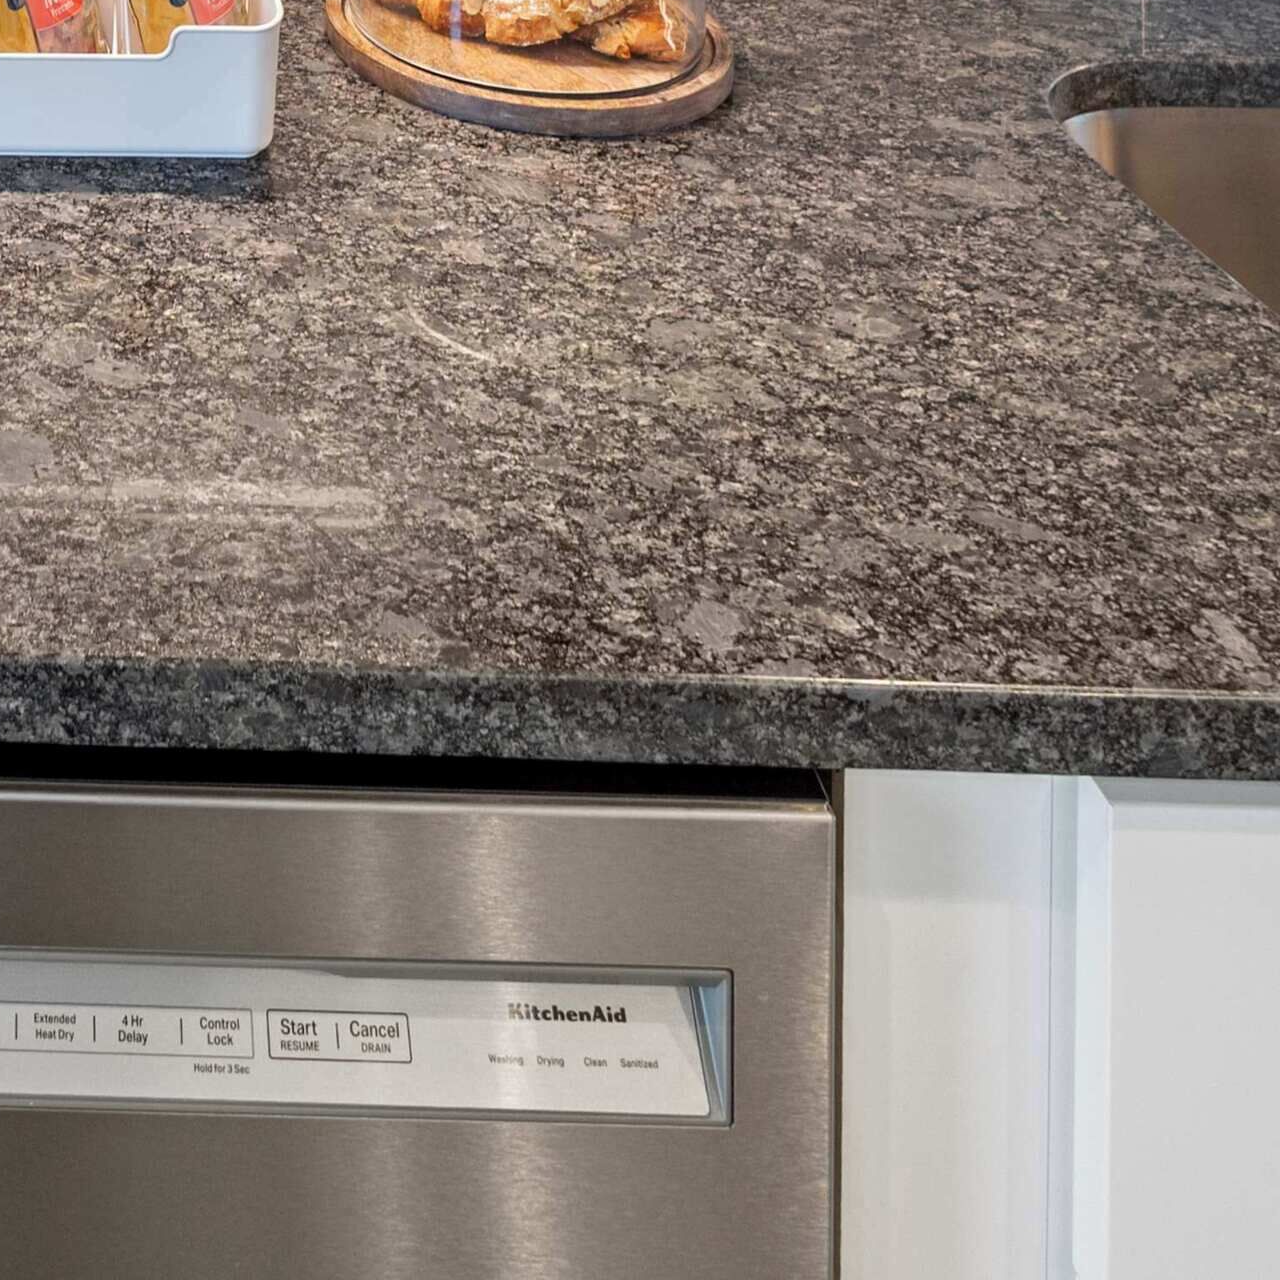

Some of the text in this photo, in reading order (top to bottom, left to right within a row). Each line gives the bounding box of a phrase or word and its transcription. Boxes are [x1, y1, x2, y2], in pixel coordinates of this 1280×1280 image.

[33, 1012, 77, 1025] Extended
[507, 1002, 628, 1024] KitchenAid
[121, 1016, 144, 1028] 4 Hr
[199, 1016, 241, 1031] Control
[280, 1017, 319, 1037] Start
[35, 1029, 75, 1042] Heat Dry
[349, 1020, 401, 1039] Cancel
[118, 1029, 149, 1046] Delay
[207, 1033, 234, 1047] Lock
[280, 1039, 321, 1052] RESUME
[361, 1042, 392, 1054] DRAIN
[536, 1055, 565, 1069] Drying
[583, 1056, 608, 1068] Clean
[619, 1058, 659, 1070] Sanitized
[193, 1063, 213, 1074] Hold
[214, 1063, 226, 1074] for
[234, 1064, 251, 1075] Sec
